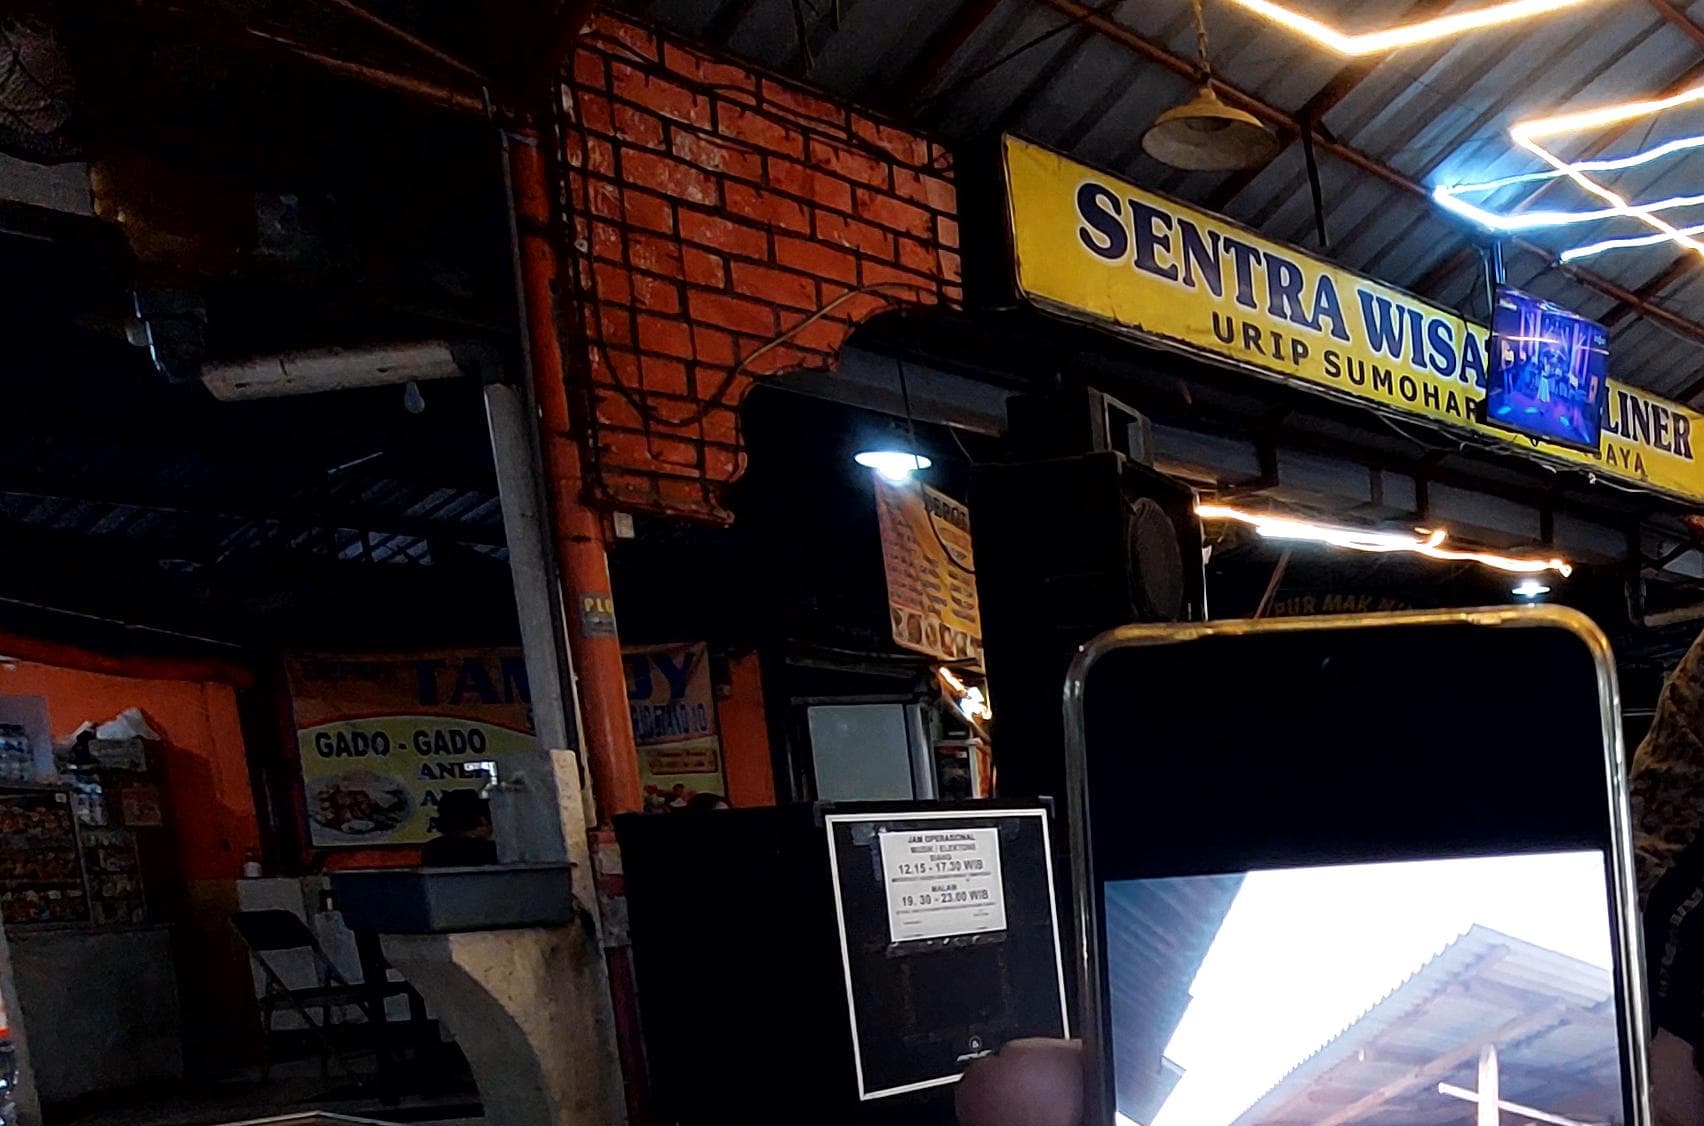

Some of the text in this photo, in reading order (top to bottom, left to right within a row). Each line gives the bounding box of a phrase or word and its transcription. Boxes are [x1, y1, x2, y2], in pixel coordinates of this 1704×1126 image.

[1077, 182, 1694, 460] SENTRA WISA LINER
[1211, 311, 1310, 366] URIP
[1323, 349, 1481, 424] SUMOHAR
[315, 731, 390, 758] GADO
[412, 728, 487, 756] GADO
[898, 863, 926, 875] 12.15
[936, 861, 961, 873] 17.30
[963, 859, 984, 870] WIB
[968, 889, 989, 901] WIB
